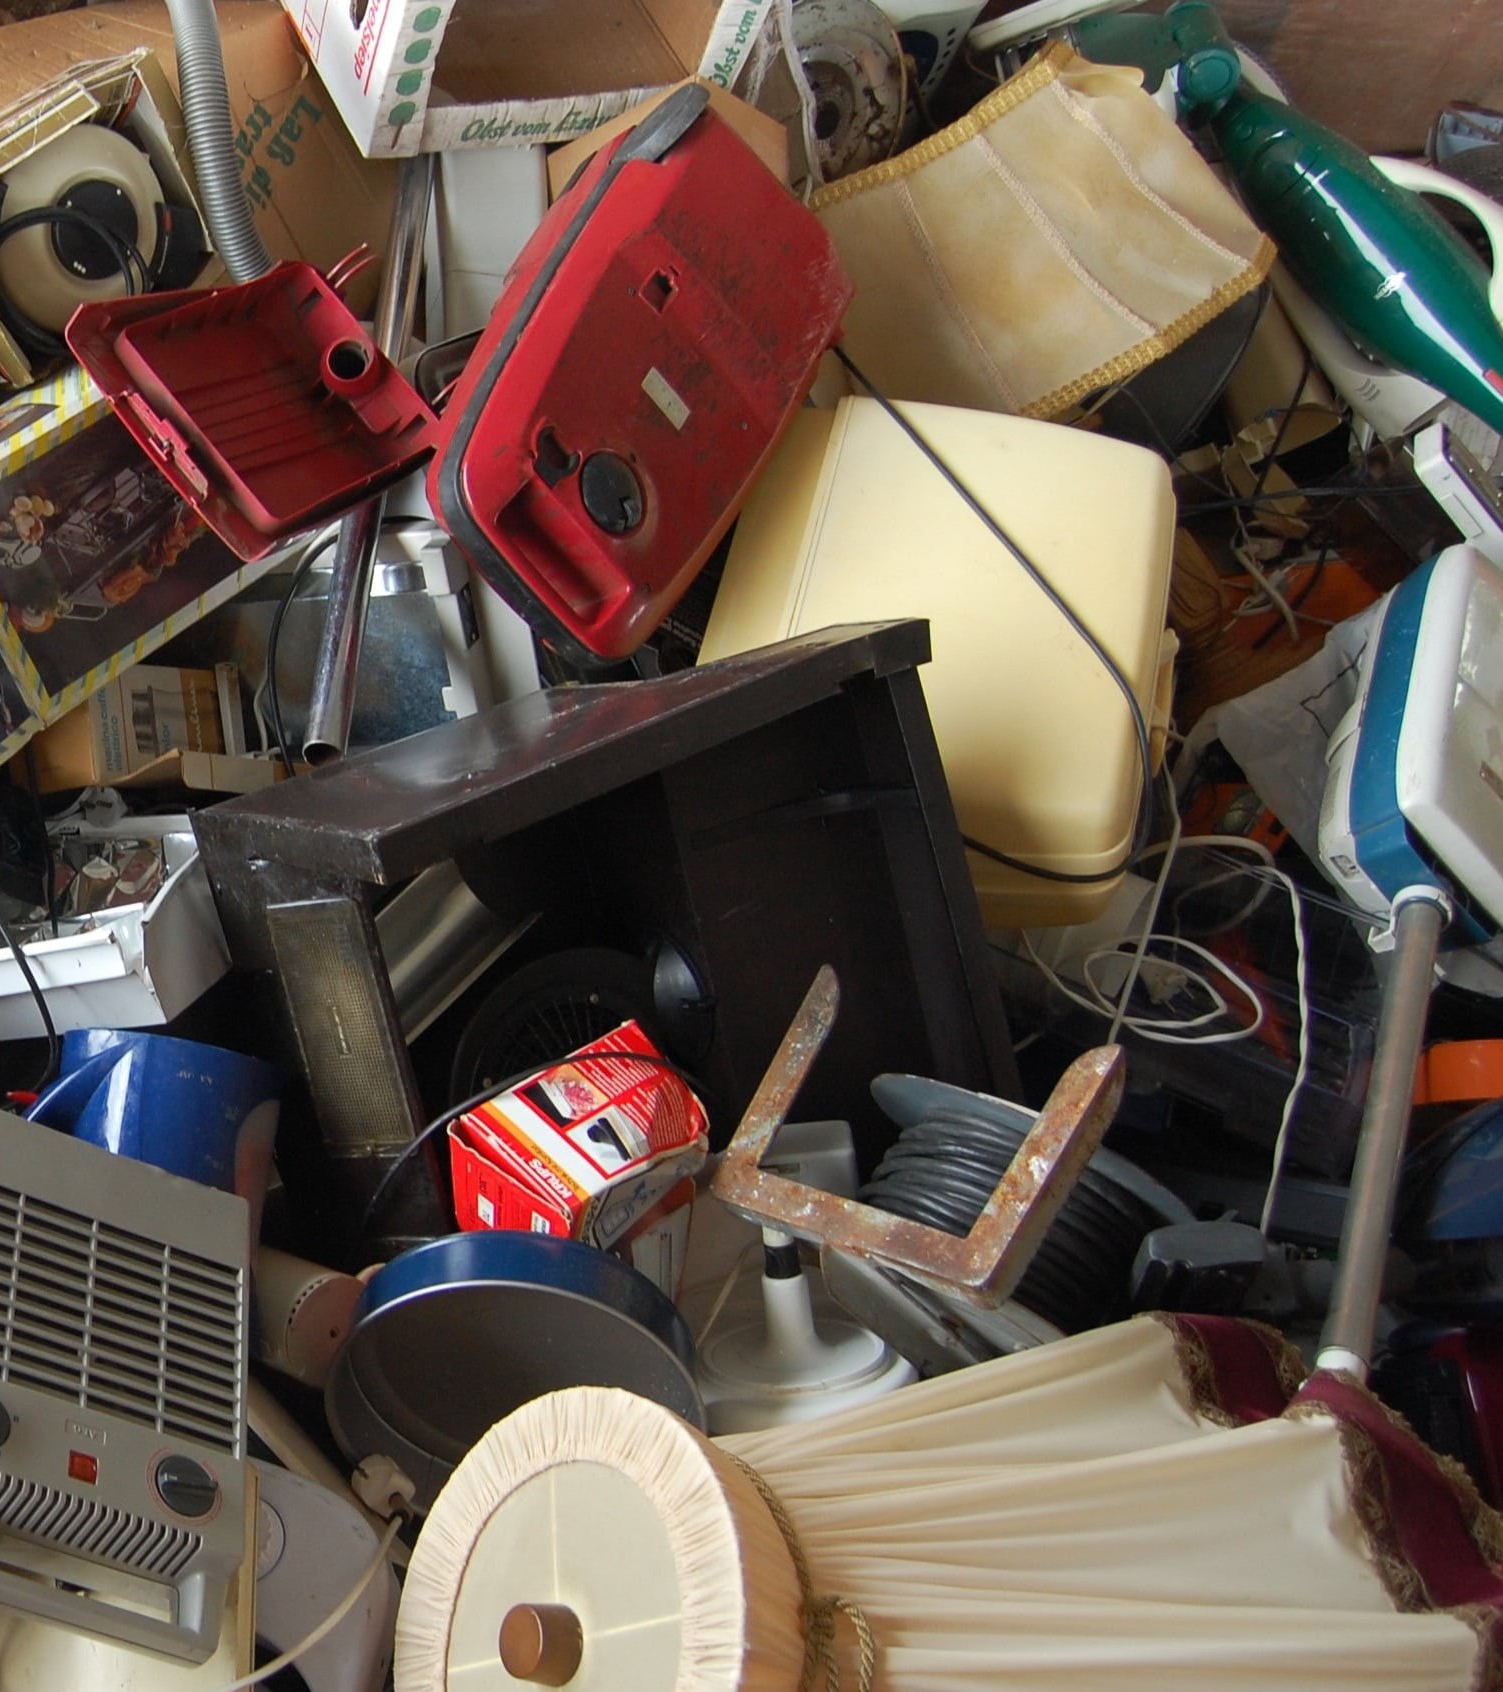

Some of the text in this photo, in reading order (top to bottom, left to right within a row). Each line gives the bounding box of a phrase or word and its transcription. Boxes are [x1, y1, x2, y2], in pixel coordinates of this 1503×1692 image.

[725, 10, 757, 44] vom
[460, 117, 512, 142] Obst
[511, 121, 551, 137] vom
[244, 96, 323, 211] Laß di
[528, 1157, 574, 1199] KRUPS
